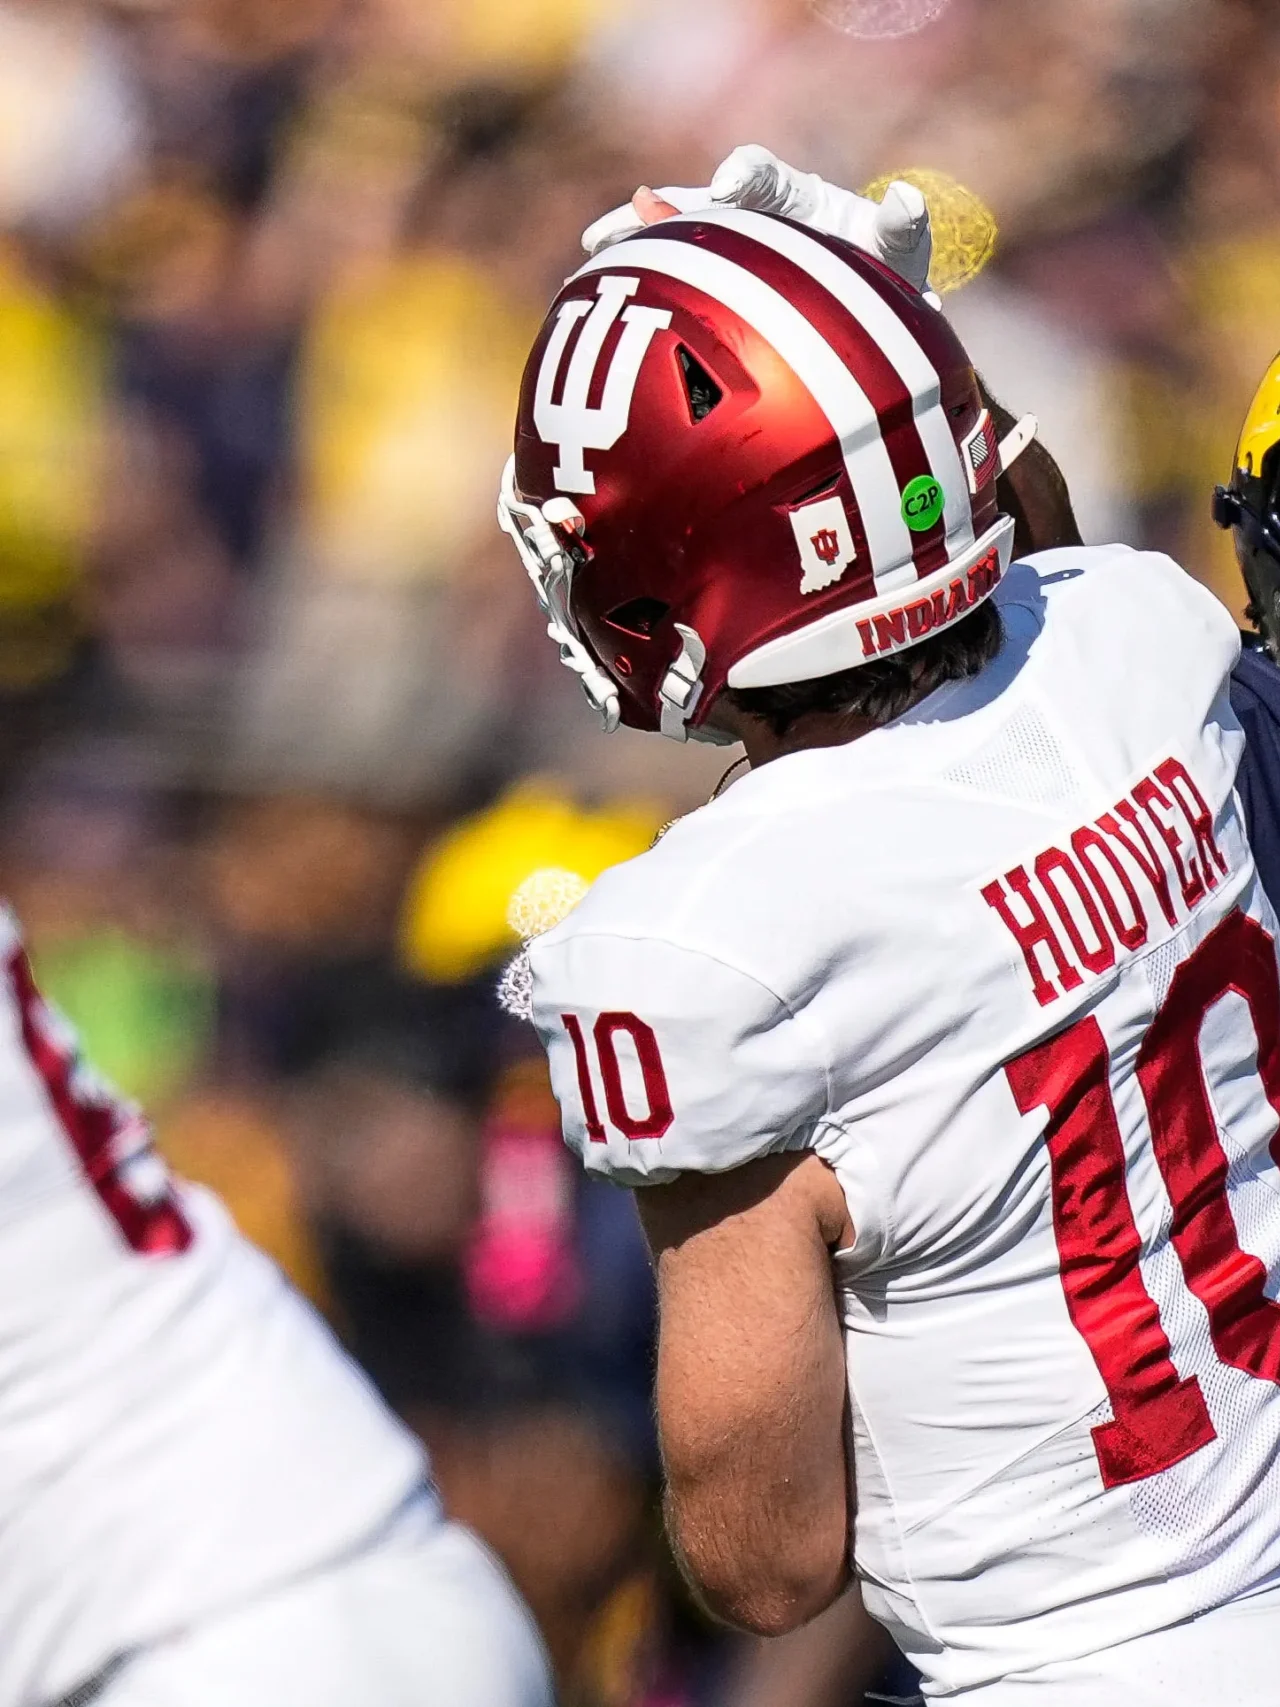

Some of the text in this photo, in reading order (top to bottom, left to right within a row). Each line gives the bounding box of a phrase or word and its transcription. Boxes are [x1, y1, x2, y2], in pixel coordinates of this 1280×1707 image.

[533, 276, 672, 494] IU
[809, 528, 840, 566] IU
[904, 485, 938, 517] C2P
[981, 758, 1229, 1007] HOOVER
[561, 1011, 675, 1144] 10
